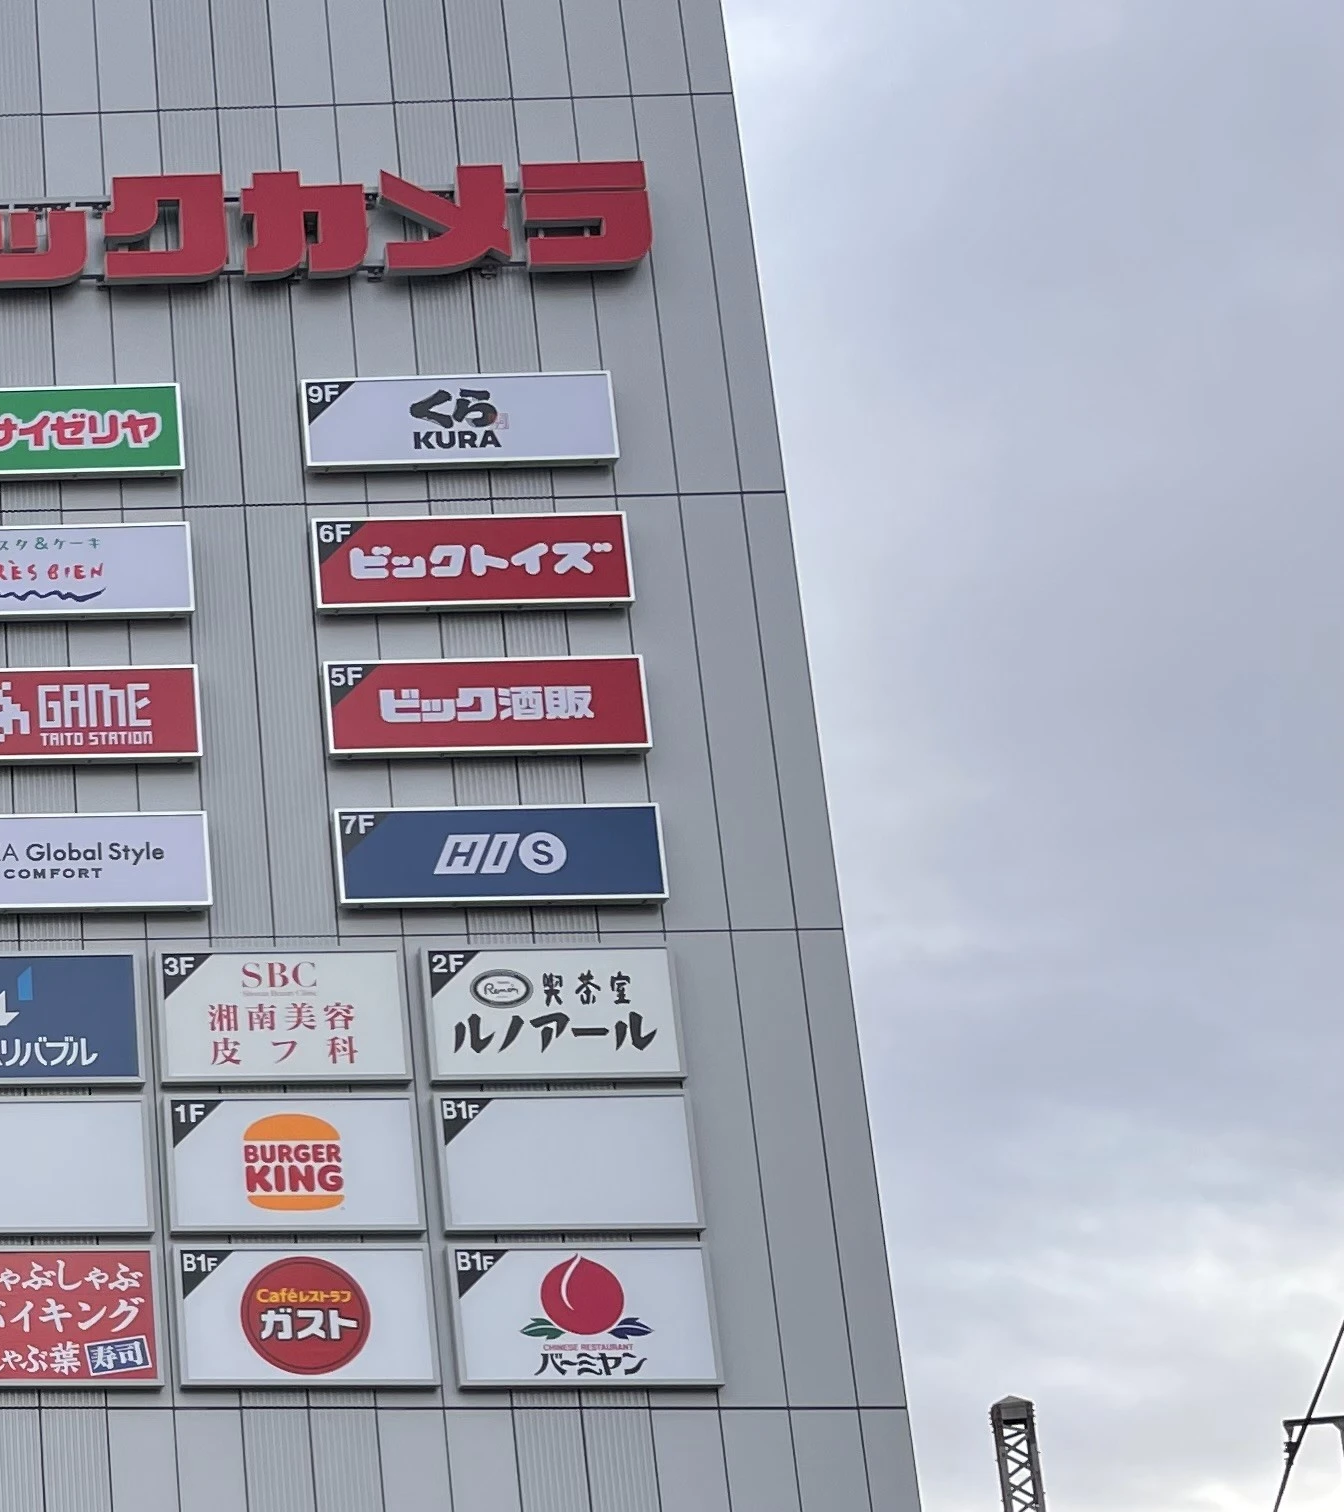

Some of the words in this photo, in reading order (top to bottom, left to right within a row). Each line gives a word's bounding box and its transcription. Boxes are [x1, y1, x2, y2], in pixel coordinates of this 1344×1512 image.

[308, 384, 340, 403] 9F
[409, 387, 498, 429] くら
[413, 429, 502, 450] KURA
[319, 524, 352, 543] 6F
[47, 561, 104, 581] BIEN
[349, 542, 612, 580] ビックトイズ
[330, 666, 363, 687] 5F
[37, 683, 152, 729] GAME
[378, 685, 595, 723] ビック酒販
[40, 731, 84, 746] TAITO
[88, 730, 153, 746] STATION
[341, 815, 375, 834] 7F
[25, 842, 103, 862] Global
[108, 841, 165, 865] Style
[3, 867, 103, 880] COMFORT
[164, 957, 195, 976] 3F
[432, 954, 464, 973] 2F
[242, 961, 317, 989] SBC
[543, 970, 632, 1008] 喫茶室
[208, 1002, 355, 1032] 湘南美容
[454, 1011, 658, 1054] ルノアール
[211, 1036, 358, 1065] 皮フ科
[174, 1104, 205, 1123] 1F
[442, 1101, 480, 1120] B1F
[243, 1144, 343, 1164] BURGER
[245, 1165, 344, 1193] KING
[182, 1253, 218, 1272] B1F
[457, 1252, 495, 1271] B1F
[261, 1308, 359, 1340] ガスト
[91, 1341, 145, 1371] 寿司
[534, 1353, 648, 1377] バーミヤン
